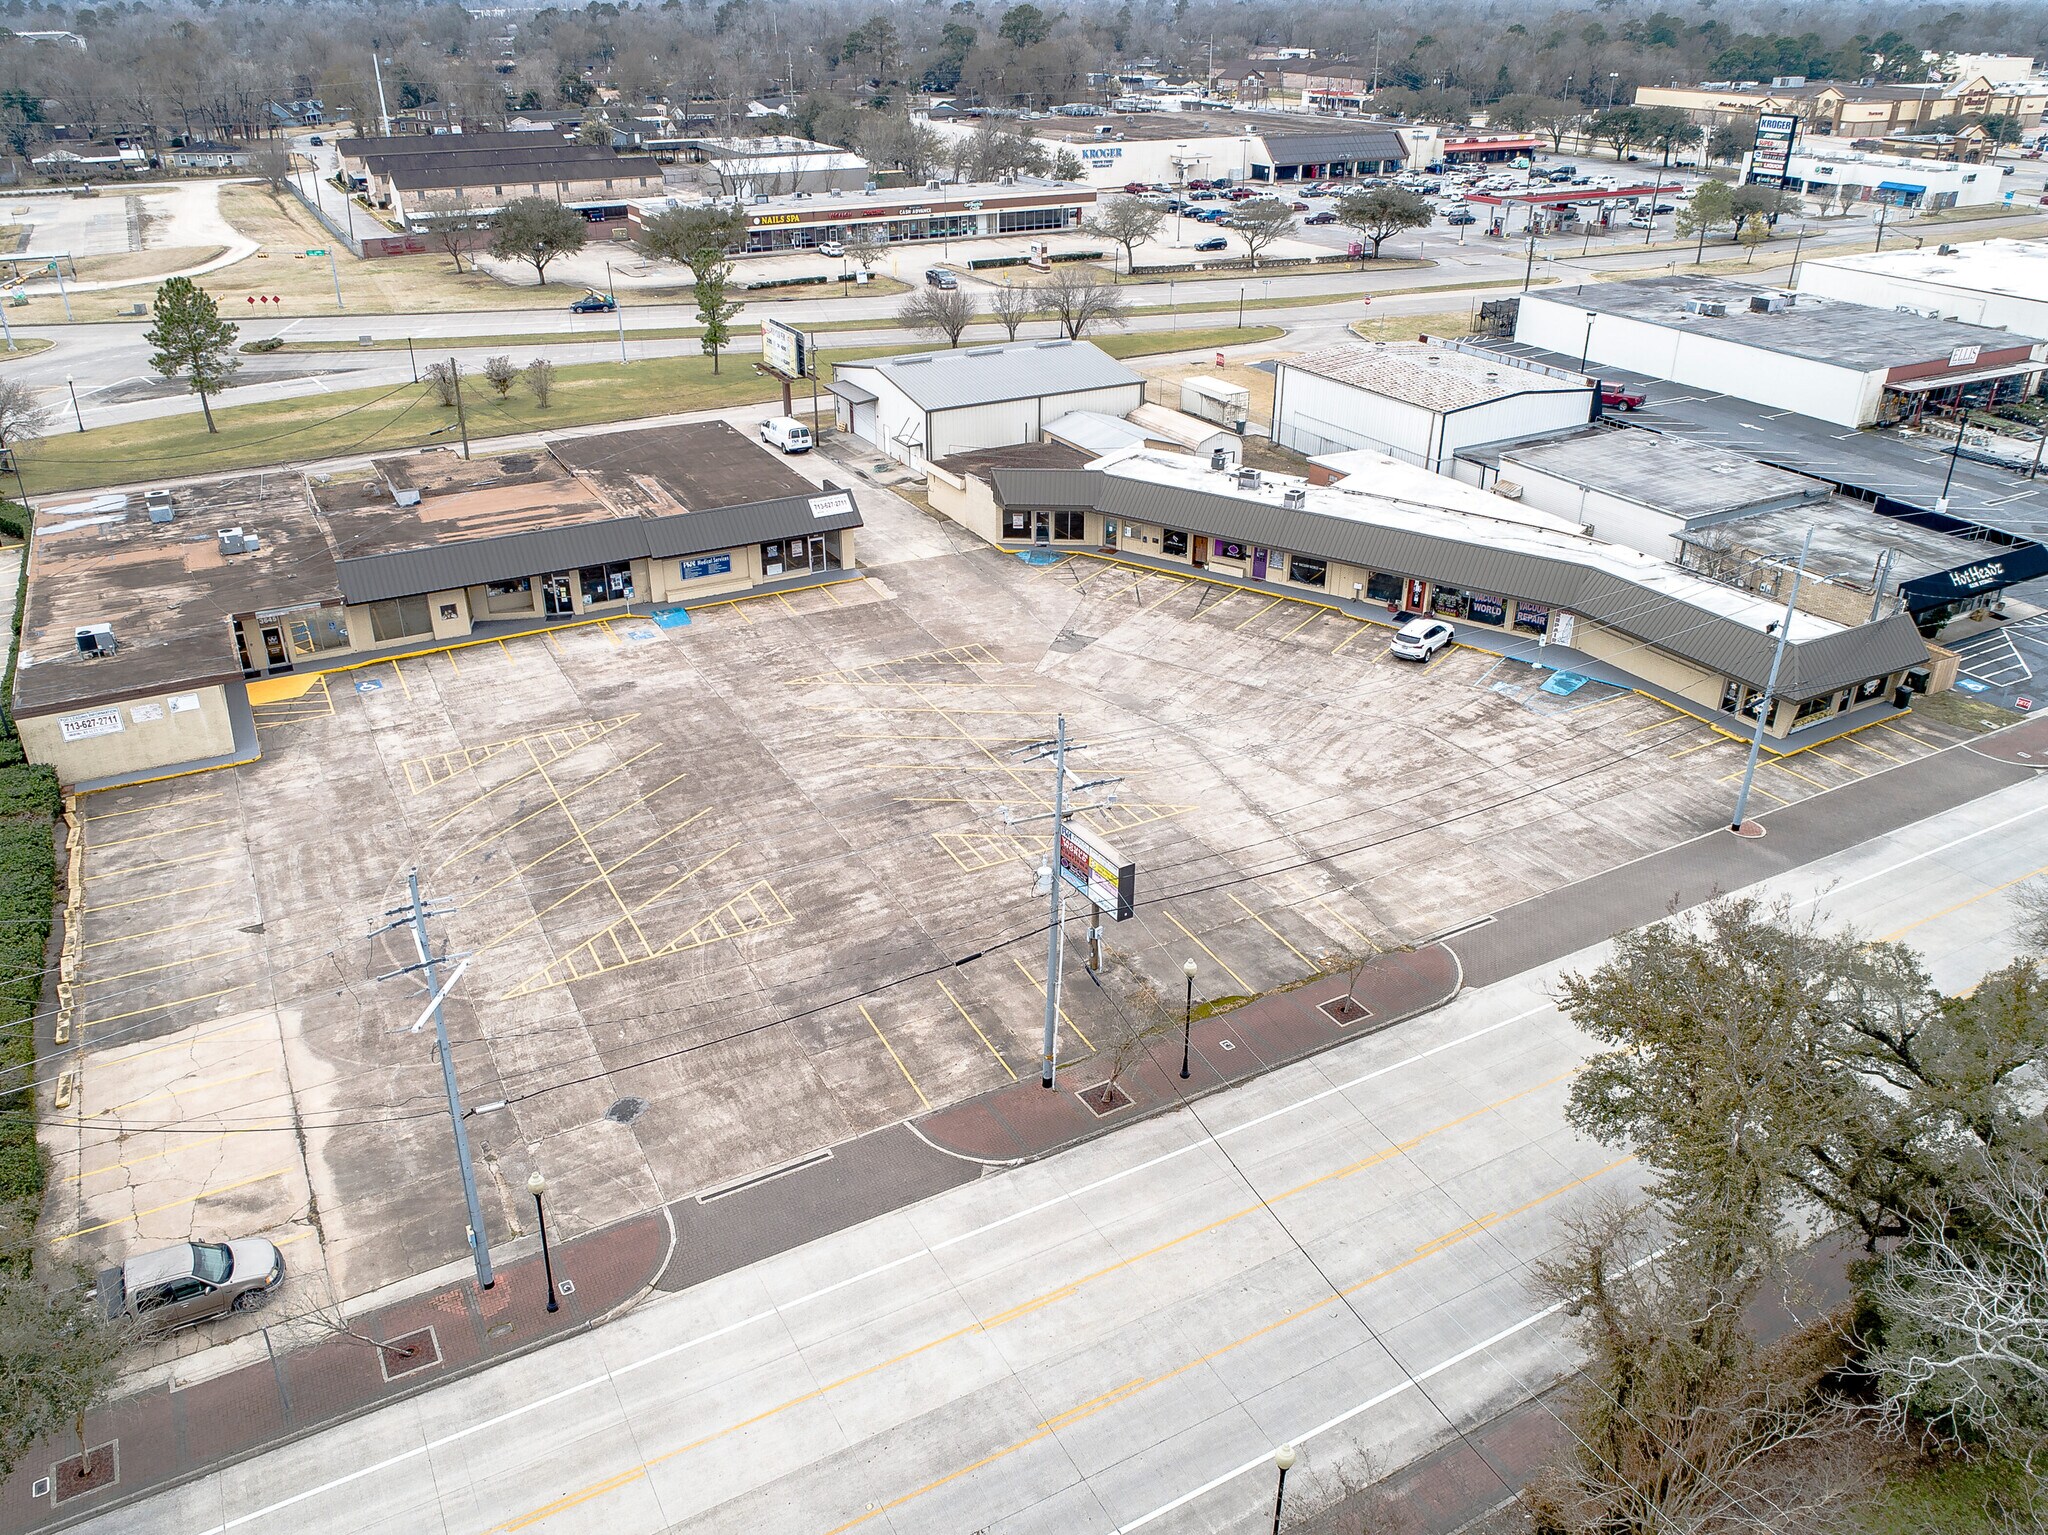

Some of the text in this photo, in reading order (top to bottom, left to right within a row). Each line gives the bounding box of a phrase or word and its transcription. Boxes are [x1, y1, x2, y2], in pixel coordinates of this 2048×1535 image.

[1761, 119, 1791, 130] KROGER
[1082, 148, 1122, 159] KROGER
[761, 214, 800, 225] NAILS SPA
[712, 555, 730, 563] Services
[1475, 592, 1504, 606] VACUUM
[1473, 602, 1502, 616] WORLD
[1519, 602, 1548, 614] VACUUM
[1517, 611, 1546, 625] REPAIR
[64, 715, 118, 732] 713-627-2711
